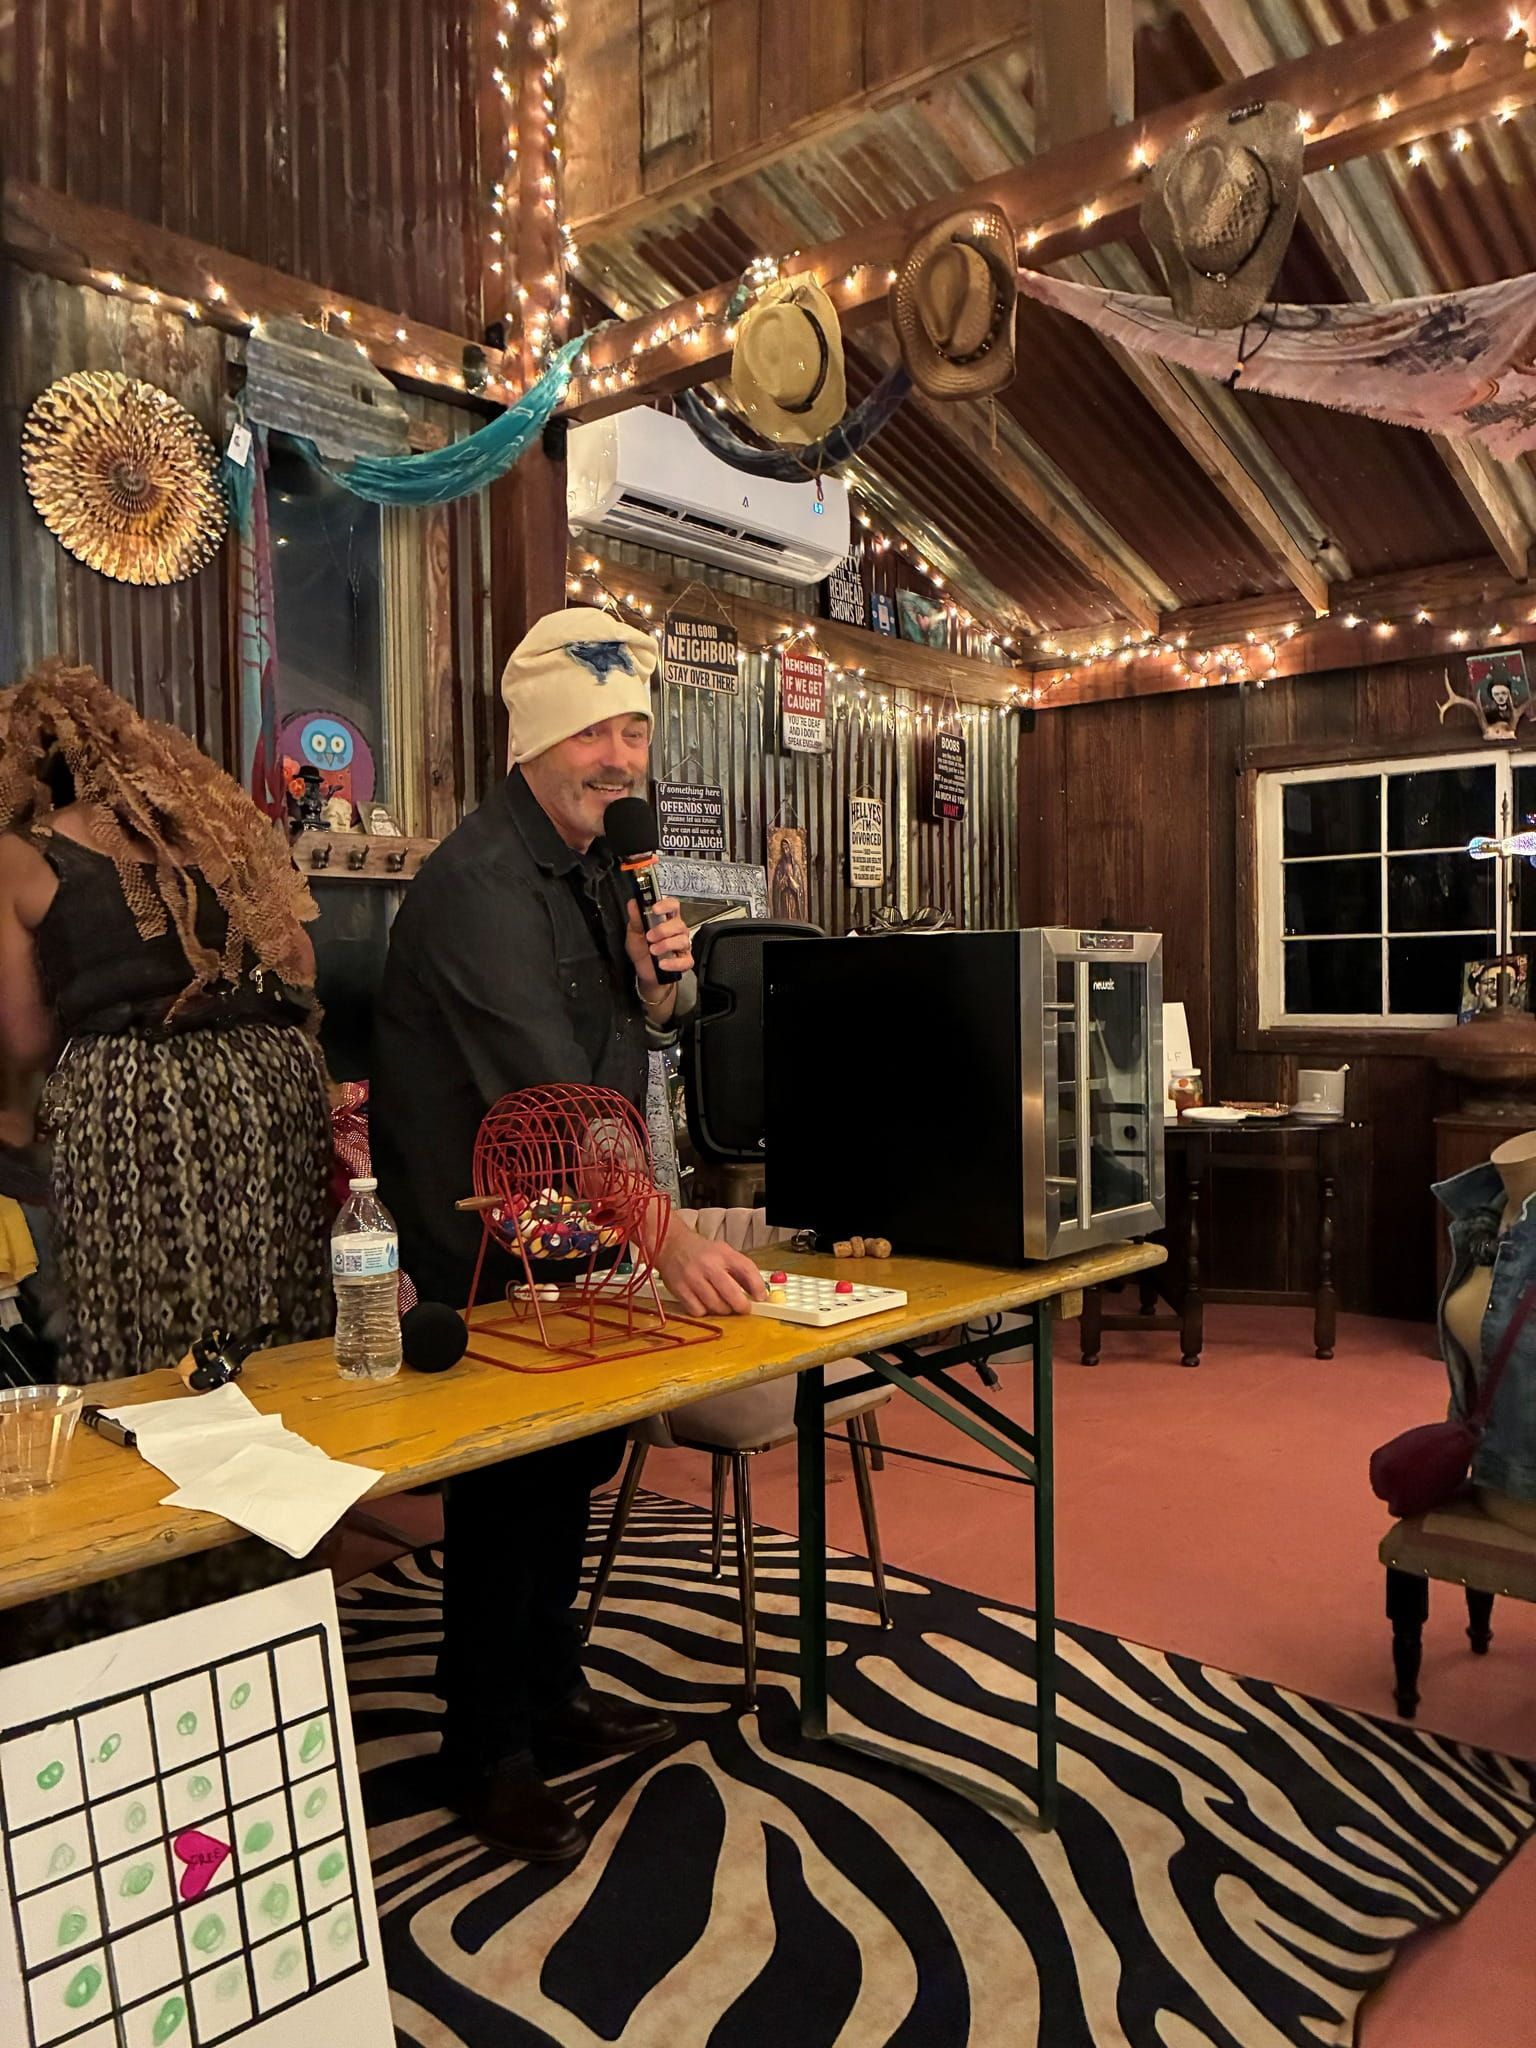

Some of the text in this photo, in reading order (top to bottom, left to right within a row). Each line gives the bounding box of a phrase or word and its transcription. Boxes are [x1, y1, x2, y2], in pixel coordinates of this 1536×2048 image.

[848, 571, 862, 585] THE
[829, 577, 864, 606] REDHEAD
[831, 598, 866, 626] SHOWS UP.
[675, 622, 718, 639] LIKE A GOOD
[668, 634, 736, 666] NEIGHBOR
[785, 656, 823, 677] REMEMBER
[668, 664, 735, 692] STAY OVER THERE
[785, 675, 823, 696] IF WE GET
[787, 693, 821, 713] CAUGHT
[789, 726, 801, 736] AND
[941, 737, 960, 753] BOOBS
[667, 785, 704, 798] something
[705, 787, 720, 796] here
[660, 800, 721, 815] OFFENDS YOU
[851, 802, 882, 826] HELL YES
[943, 803, 959, 817] WANT
[662, 835, 723, 849] GOOD LAUGH
[852, 832, 882, 846] DIVORCED
